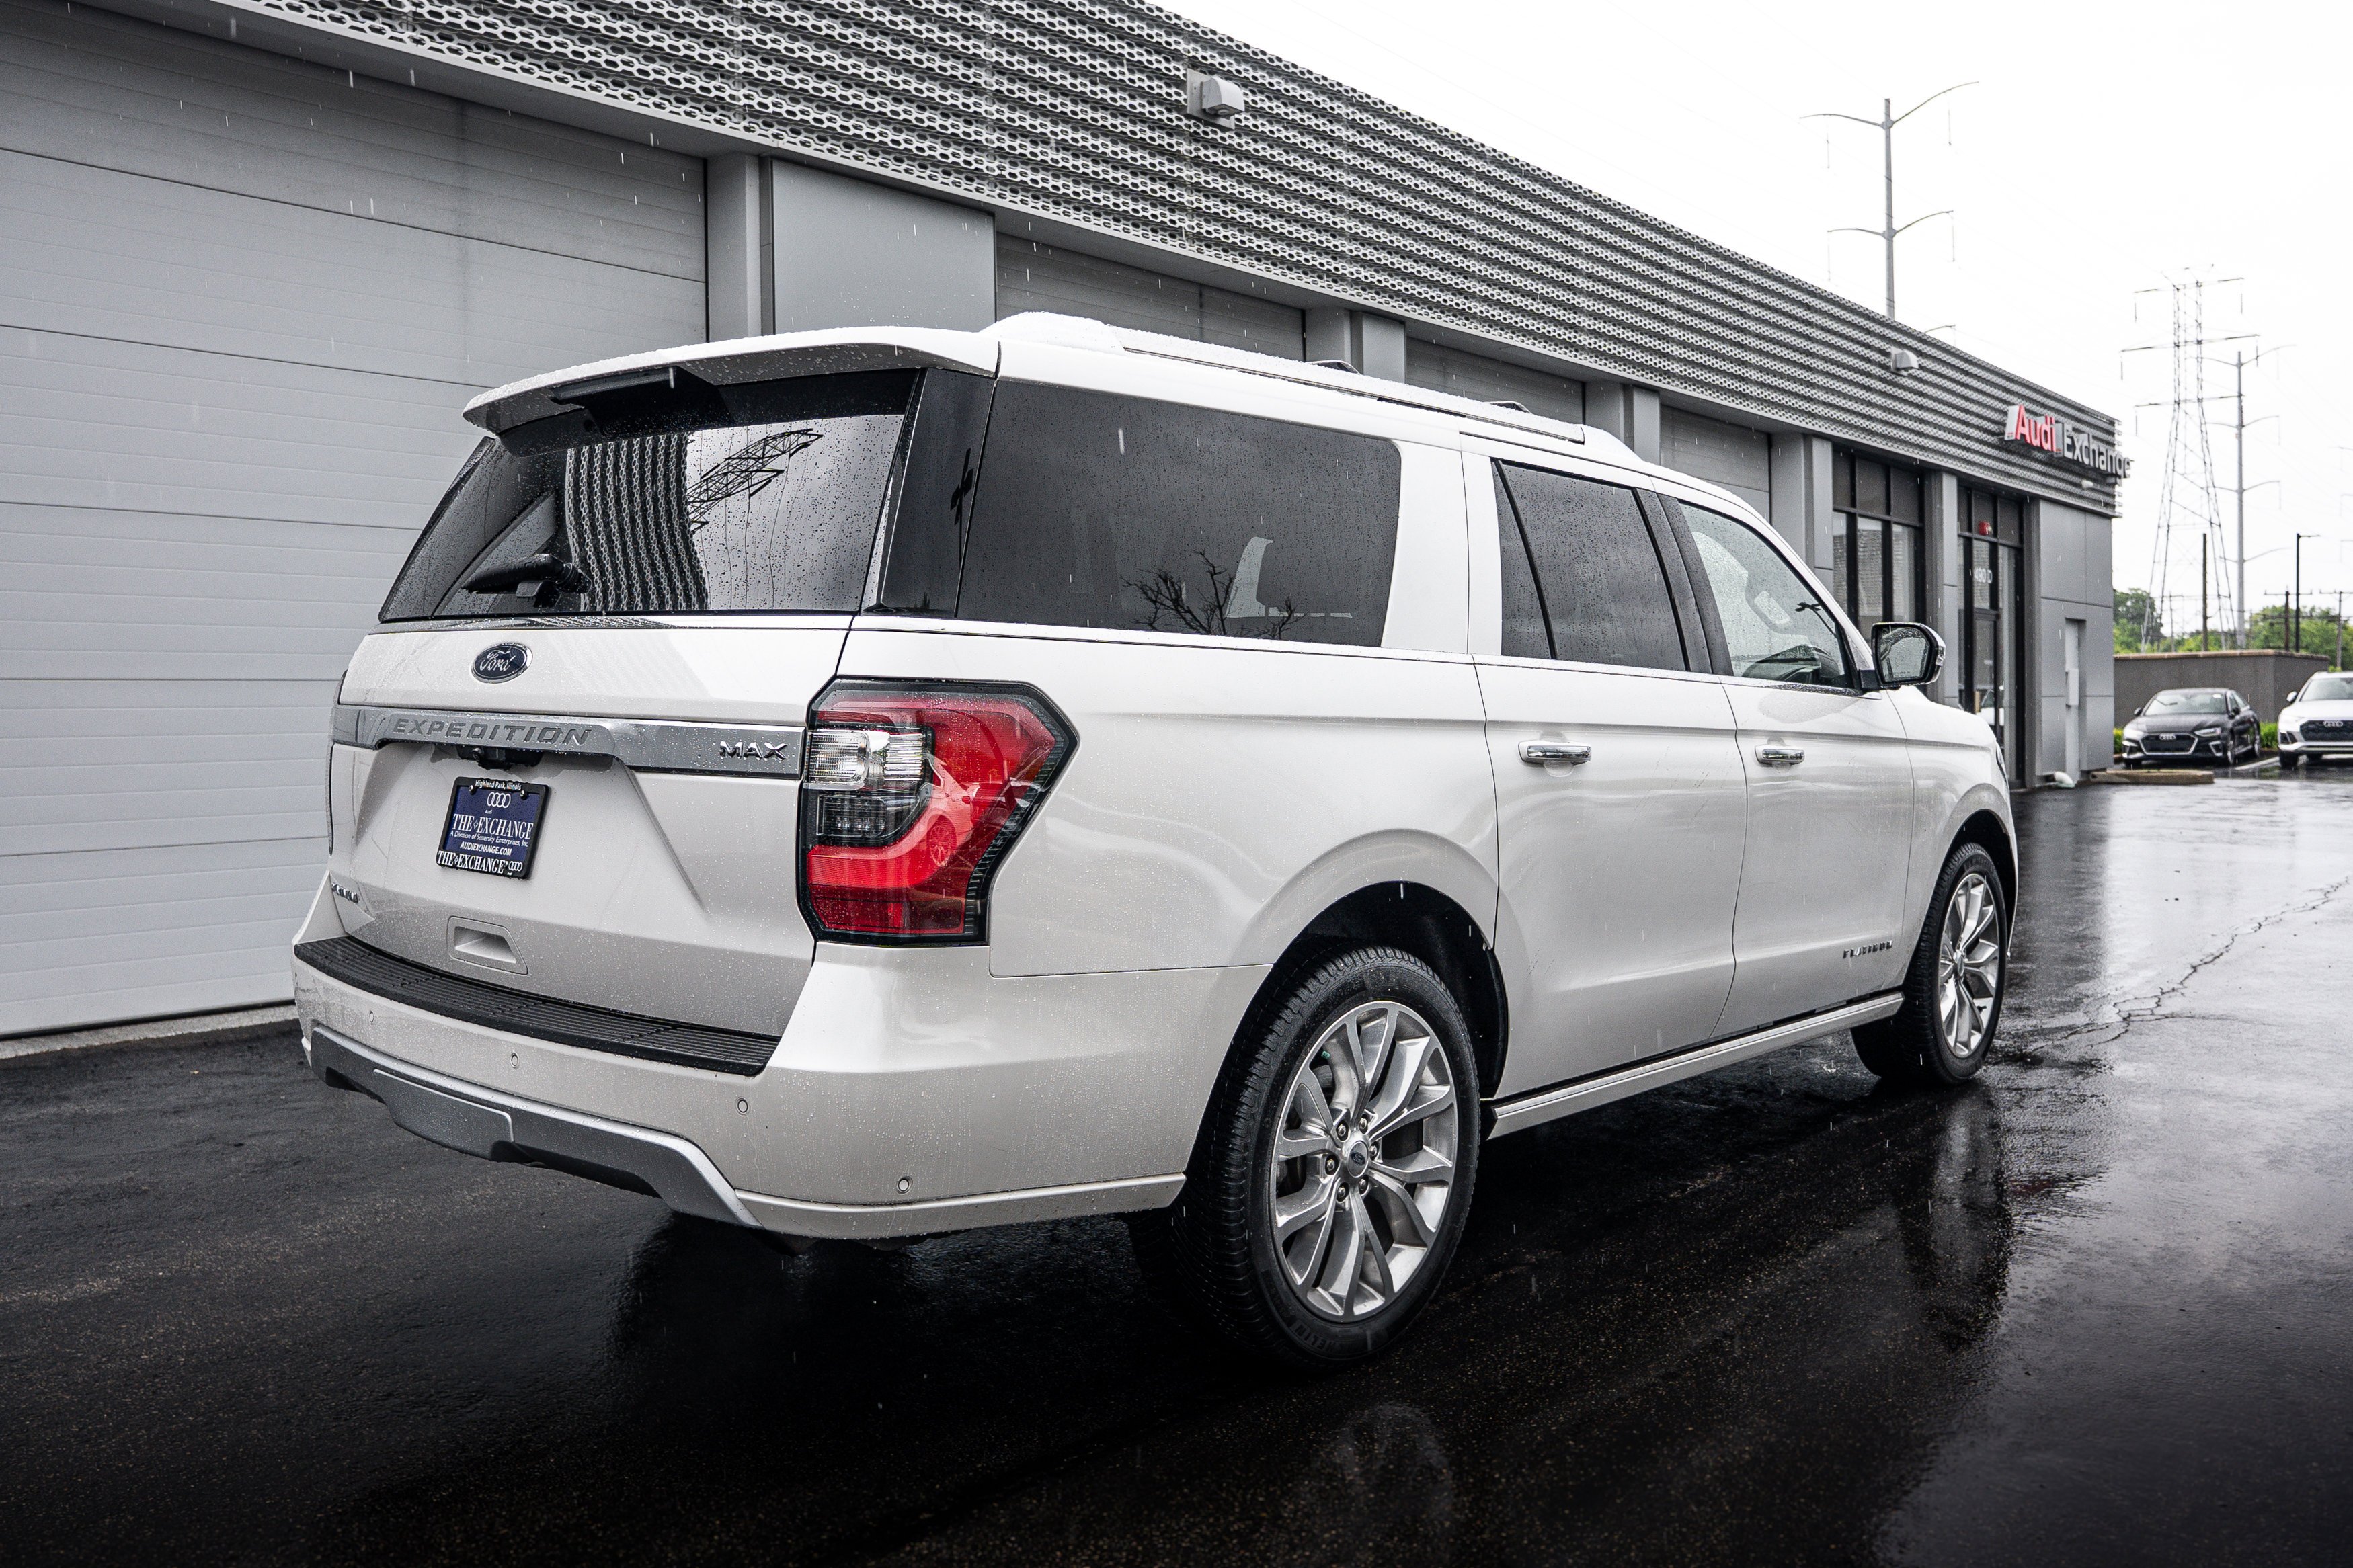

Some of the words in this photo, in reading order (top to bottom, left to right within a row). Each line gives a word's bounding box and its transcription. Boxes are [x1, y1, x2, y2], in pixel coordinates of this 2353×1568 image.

[2015, 404, 2056, 452] Audi
[2061, 422, 2131, 487] Exchange
[479, 649, 516, 671] Ford
[393, 718, 592, 746] EXPEDITION
[719, 741, 788, 760] MAX
[475, 780, 495, 788] Highland
[506, 782, 522, 790] Illinois
[452, 813, 475, 832] THE
[476, 817, 534, 839] EXCHANGE
[454, 831, 471, 839] Division
[438, 850, 456, 866] THE
[460, 841, 512, 856] AUDIEXCHANGE.COM
